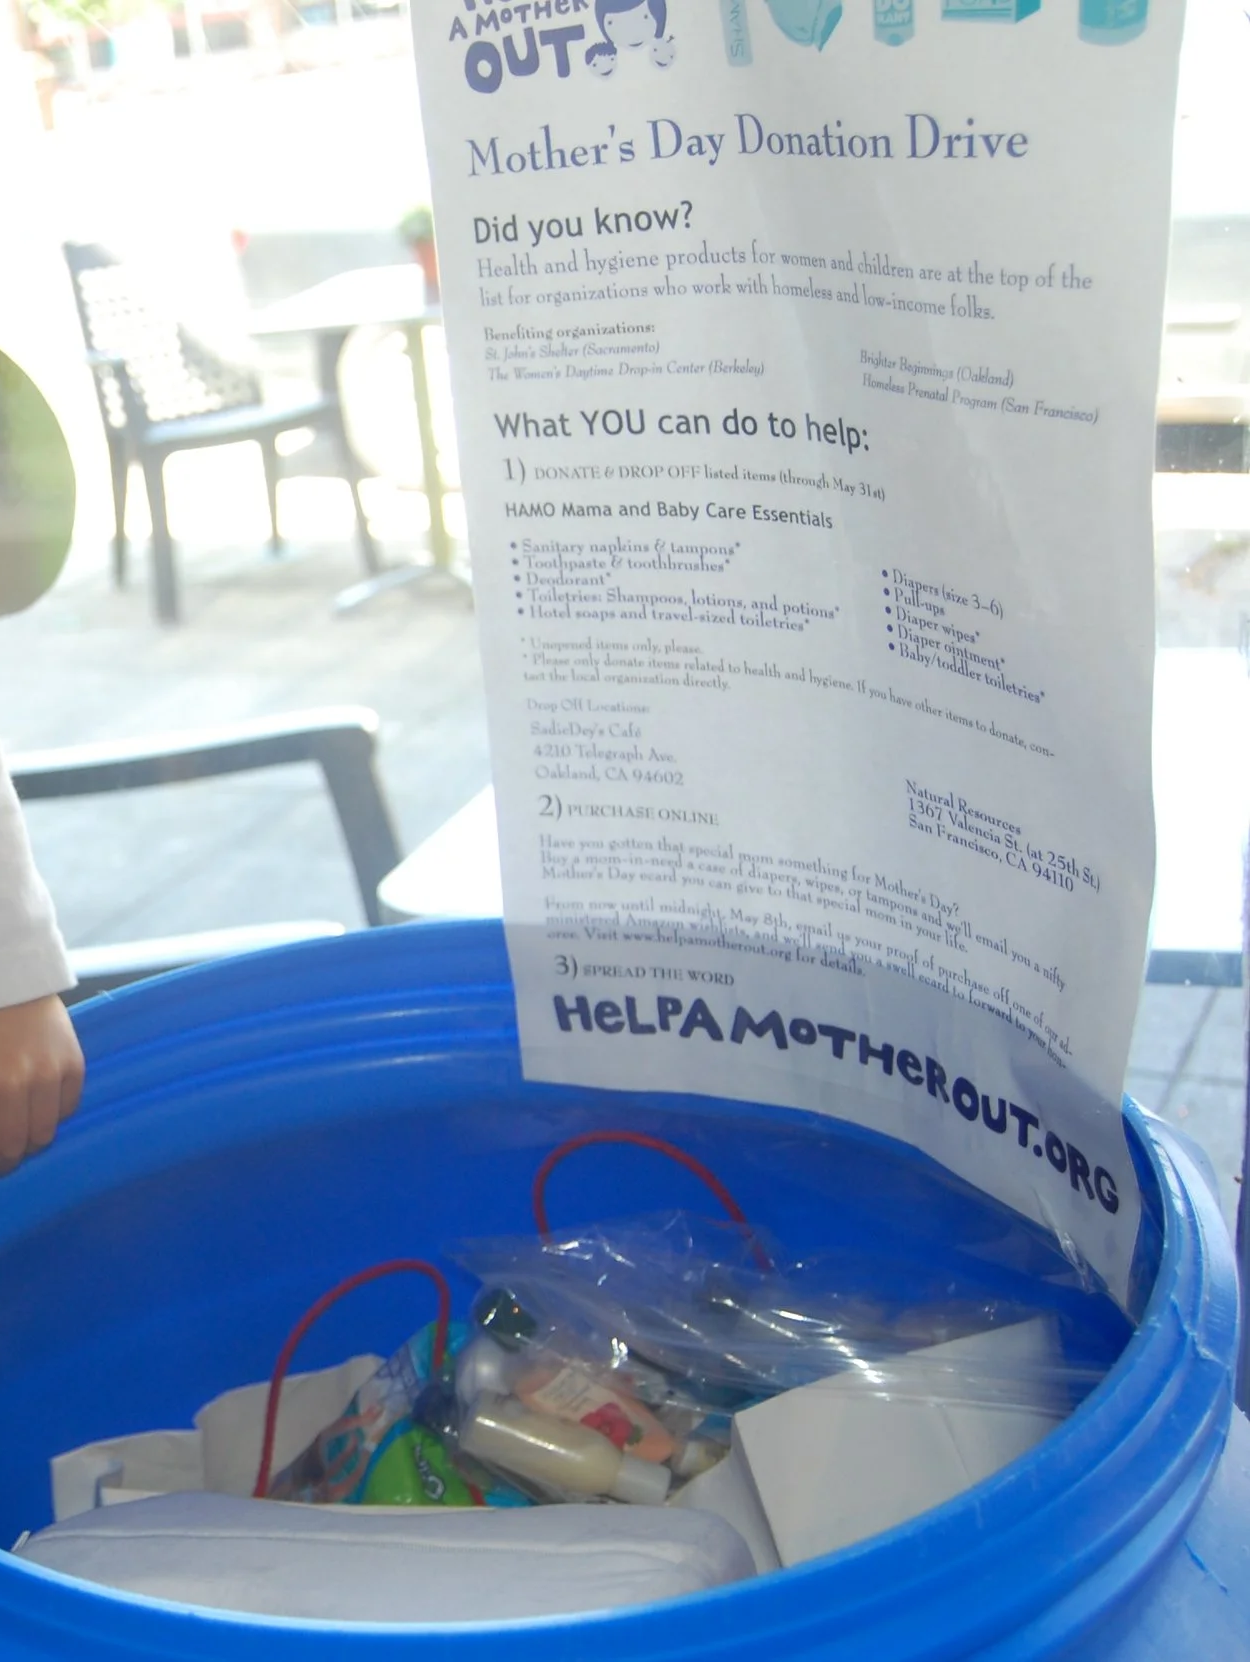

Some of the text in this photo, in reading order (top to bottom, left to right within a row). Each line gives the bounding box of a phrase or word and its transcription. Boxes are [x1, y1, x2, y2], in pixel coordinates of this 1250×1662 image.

[449, 17, 468, 41] A
[464, 24, 585, 93] OUT
[465, 113, 1029, 176] Mother's Day Donation Drive
[474, 200, 693, 247] Did you know?
[477, 239, 1092, 291] Health and hygiene products for women and children are at the top of the
[480, 273, 995, 320] list for organizations who work with homeless and low-income folks.
[557, 323, 655, 338] organizations:
[582, 340, 660, 358] (Sacramento)
[488, 359, 764, 381] The Women's Daytime Drop-in Center (Berkeley)
[860, 350, 897, 370] Brighter
[956, 366, 1014, 389] (Oakland)
[863, 373, 1099, 425] Homeless Prenatal Program (San Francisco)
[494, 408, 870, 455] What YOU can do to help:
[502, 457, 886, 501] 1) DONATE & DROP OFF listed items (through May 31st)
[505, 500, 833, 530] HAMO Mama and Baby Care Essentials
[522, 537, 584, 556] Sanitary
[590, 536, 649, 555] napkins
[523, 555, 607, 572] Toothpaste
[691, 590, 747, 610] lotions,
[751, 595, 778, 612] and
[892, 568, 939, 597] Diapers
[942, 583, 968, 606] (size
[894, 586, 945, 617] Pull-ups
[529, 604, 571, 620] Hotel
[575, 606, 616, 624] soaps
[619, 606, 647, 621] and
[651, 606, 736, 626] travel-sized
[896, 605, 939, 631] Diaper
[898, 623, 940, 649] Diaper
[899, 642, 982, 682] Baby/toddler
[577, 744, 643, 763] Telegraph
[535, 765, 685, 786] Oakland, CA 94602
[538, 793, 719, 826] 2) PURCHASE ONLINE
[906, 779, 1021, 835] Natural Resources
[908, 813, 1074, 893] San Francisco, CA 94110
[909, 797, 1100, 894] 1367 Valencia St. (at 25th St.)
[539, 834, 960, 917] Have you gotten that special mom something for Mother's Day?
[585, 927, 618, 941] Visit
[554, 954, 734, 986] 3) SPREAD THE WORD
